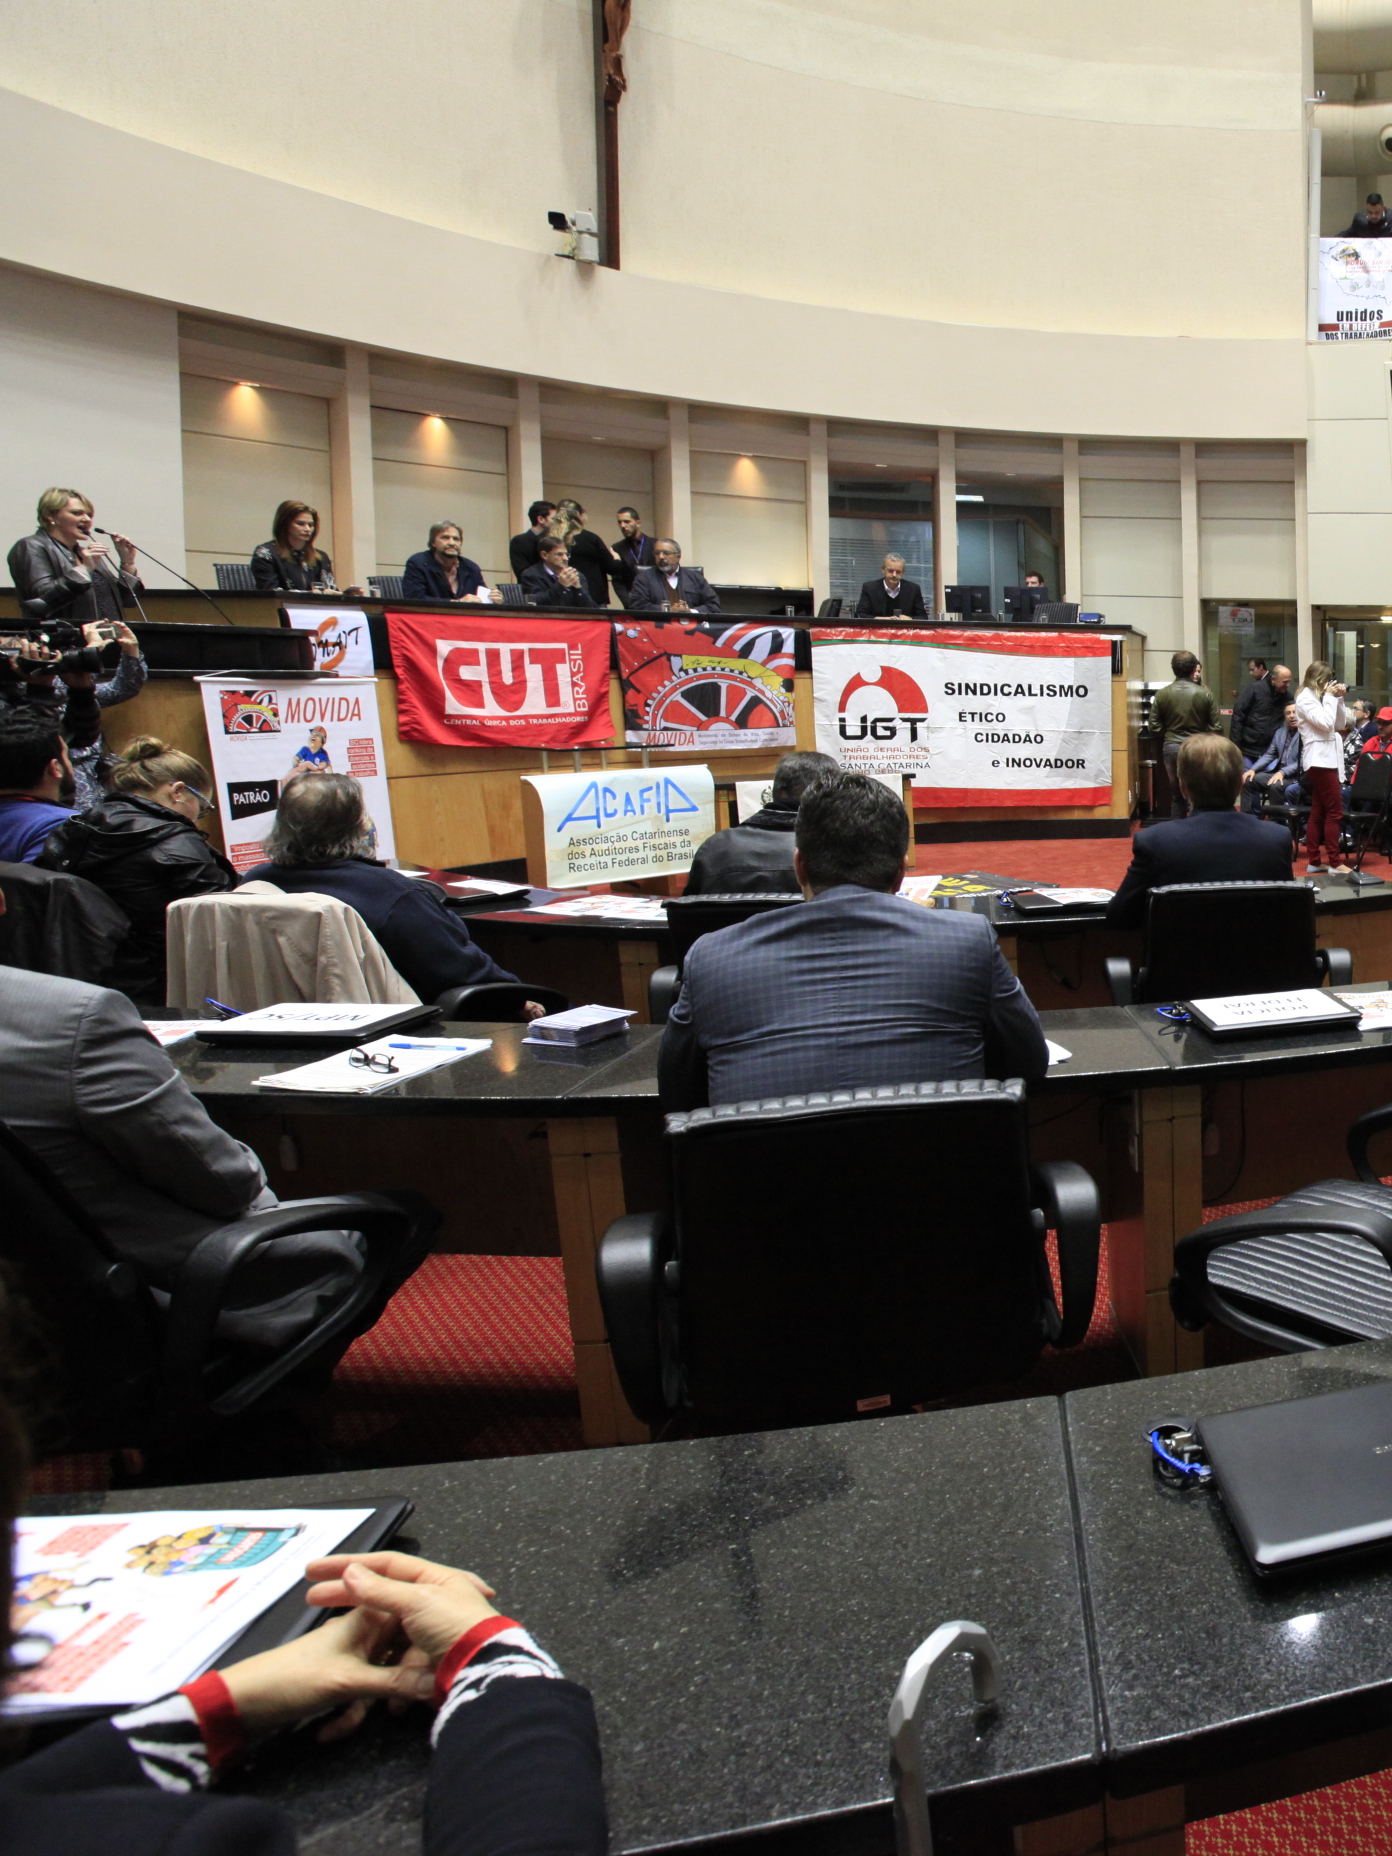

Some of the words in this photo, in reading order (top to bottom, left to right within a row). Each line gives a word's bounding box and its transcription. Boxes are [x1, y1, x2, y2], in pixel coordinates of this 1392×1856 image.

[1336, 308, 1384, 322] unidos
[1325, 331, 1339, 340] DOS
[441, 647, 567, 713] CUT
[569, 643, 589, 712] BRASIL
[944, 682, 1089, 698] SINDICALISMO
[285, 697, 362, 724] MOVIDA
[958, 707, 1007, 723] ÉTICO
[443, 718, 481, 726] CENTRAL
[484, 717, 507, 726] ÚNICA
[509, 718, 526, 726] DOS
[529, 715, 589, 726] TRABALHADORES
[838, 713, 928, 744] UGT
[974, 731, 1044, 744] CIDADÃO
[840, 745, 870, 753] UNIÃO
[840, 762, 875, 771] SANTA
[878, 762, 932, 770] CATARINA
[991, 758, 1001, 769] e
[1006, 757, 1086, 770] INOVADOR
[233, 789, 270, 805] PATRÃO
[556, 776, 700, 833] ACAFIA
[568, 832, 629, 848] Associação
[631, 827, 690, 842] Catarinense
[567, 850, 587, 861] dos
[589, 844, 640, 859] Auditores
[643, 840, 677, 852] Fiscais
[680, 838, 692, 849] da
[568, 859, 609, 873] Receita
[611, 853, 649, 868] Federal
[651, 852, 664, 864] do
[666, 850, 695, 862] Brasil
